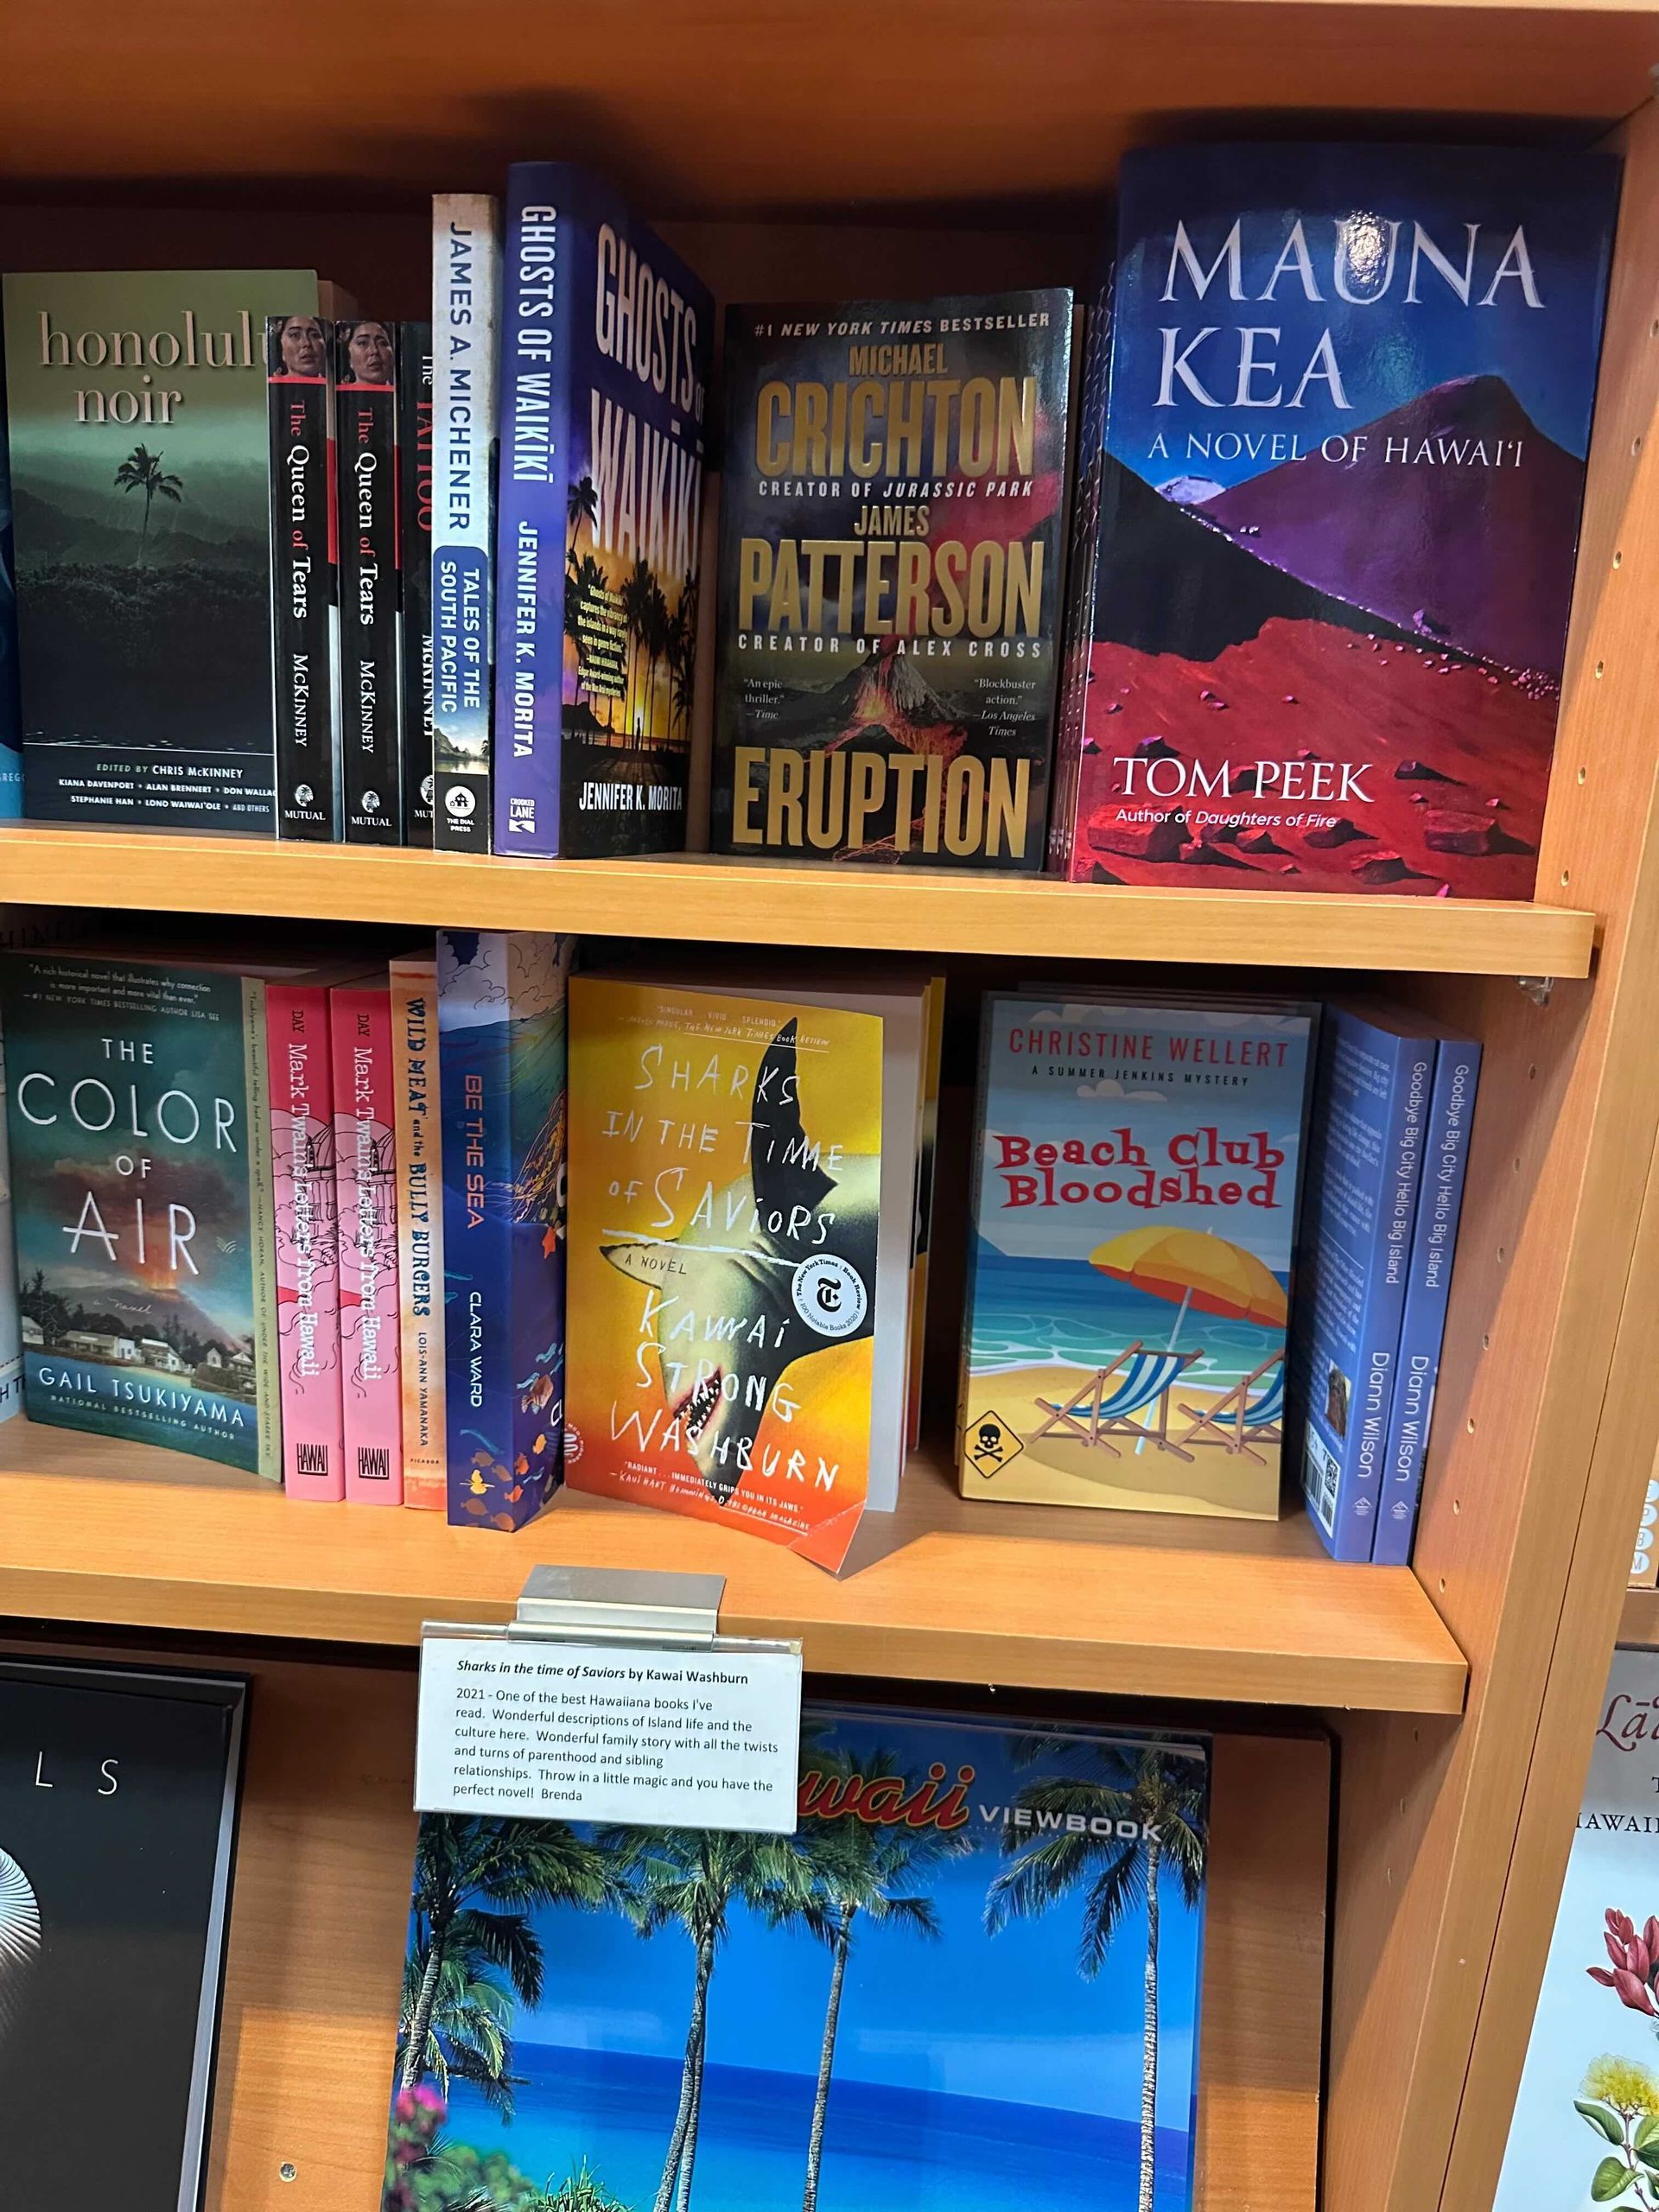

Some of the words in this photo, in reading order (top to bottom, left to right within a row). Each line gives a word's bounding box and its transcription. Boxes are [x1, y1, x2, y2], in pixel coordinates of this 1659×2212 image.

[450, 221, 472, 326] JAMES
[518, 206, 556, 317] GHOSTS
[1158, 218, 1546, 308] MAUNA
[450, 335, 471, 360] A.
[518, 328, 553, 362] OF
[754, 323, 772, 337] #1
[781, 323, 819, 336] NEW
[828, 322, 872, 335] YORK
[881, 321, 932, 334] TIMES
[940, 312, 1050, 333] BESTSELLER
[849, 342, 948, 376] MICHAEL
[1152, 327, 1355, 409] KEA
[74, 374, 182, 423] noir
[290, 400, 306, 436] The
[449, 369, 471, 530] MICHENER
[756, 376, 1037, 477] CRICHTON
[1147, 433, 1168, 460] A
[1186, 432, 1306, 461] NOVEL
[1321, 435, 1368, 463] OF
[287, 444, 309, 522] Queen
[759, 480, 841, 498] CREATOR
[851, 480, 873, 498] OF
[883, 480, 976, 498] JURASSIC
[986, 480, 1033, 497] PARK
[292, 530, 308, 550] of
[854, 505, 931, 537] JAMES
[292, 556, 311, 619] Tears
[441, 562, 457, 629] SOUTH
[463, 568, 480, 632] TALES
[516, 521, 537, 635] JENNIFER
[739, 537, 1045, 639] PATTERSON
[463, 637, 480, 664] OF
[515, 642, 535, 664] K.
[739, 634, 839, 653] CREATOR
[856, 639, 881, 654] OF
[898, 639, 951, 657] ALEX
[969, 641, 1041, 658] CROSS
[441, 636, 457, 713] PACIFIC
[463, 671, 480, 709] THE
[293, 654, 309, 747] McKINNEY
[513, 671, 535, 758] MORITA
[97, 764, 130, 772] EDITED
[152, 766, 184, 776] CHRIS
[188, 766, 244, 779] McKINNEY
[1113, 757, 1231, 798] TOM
[1255, 760, 1375, 803] PEEK
[285, 810, 326, 821] MUTUAL
[510, 806, 535, 818] LANE
[733, 747, 1030, 858] ERUPTION
[1116, 809, 1172, 823] Author
[1175, 810, 1192, 824] of
[1195, 811, 1281, 828] Daughters
[1285, 813, 1305, 827] of
[1306, 814, 1337, 828] Fire
[292, 1010, 304, 1033] DAY
[406, 998, 426, 1052] WILD
[101, 1039, 154, 1065] THE
[289, 1043, 309, 1099] Mark
[1009, 1027, 1154, 1061] CHRISTINE
[1169, 1038, 1289, 1067] WELLERT
[408, 1059, 428, 1117] MEAT
[465, 1075, 482, 1110] BE
[634, 1043, 800, 1106] SHARKS
[1032, 1065, 1039, 1075] A
[1048, 1065, 1106, 1078] SUMMER
[1115, 1068, 1174, 1083] JENKINS
[1185, 1073, 1249, 1087] MYSTERY
[1404, 1062, 1427, 1123] Goodbye
[18, 1073, 236, 1153] COLOR
[412, 1120, 423, 1138] and
[1400, 1127, 1419, 1148] Big
[413, 1141, 425, 1156] the
[465, 1116, 483, 1167] THE
[602, 1109, 643, 1143] IN
[658, 1120, 718, 1154] THE
[735, 1121, 843, 1171] TIME
[993, 1128, 1151, 1168] Beach
[1168, 1127, 1285, 1169] Club
[1396, 1150, 1415, 1179] City
[116, 1155, 151, 1179] OF
[1001, 1166, 1282, 1209] Bloodshed
[295, 1182, 314, 1254] Letters
[409, 1164, 429, 1224] BULLY
[467, 1173, 484, 1229] SEA
[1395, 1182, 1412, 1217] Hello
[62, 1191, 199, 1275] AIR
[1388, 1219, 1407, 1241] Big
[296, 1258, 315, 1307] from
[411, 1230, 430, 1317] BURGERS
[625, 1254, 632, 1265] A
[640, 1255, 688, 1275] NOVEL
[1385, 1244, 1404, 1285] Island
[301, 1313, 320, 1377] Hawaii
[469, 1292, 482, 1351] CLARA
[417, 1332, 428, 1388] LOIS-ANN
[469, 1356, 482, 1408] WARD
[636, 1340, 801, 1423] STRONG
[1366, 1352, 1389, 1411] Diann
[39, 1368, 97, 1393] GAIL
[111, 1379, 244, 1427] TSUKIYAMA
[419, 1389, 429, 1446] YAMANAKA
[611, 1401, 839, 1491] WASHBURN
[1357, 1415, 1382, 1478] Wilson
[457, 1660, 496, 1672] Sharks
[499, 1662, 511, 1673] in
[514, 1662, 534, 1675] the
[537, 1664, 563, 1675] time
[567, 1665, 581, 1679] of
[582, 1666, 626, 1678] Saviors
[629, 1668, 643, 1681] by
[646, 1669, 683, 1681] Kawai
[686, 1671, 748, 1684] Washburn
[456, 1688, 484, 1700] 2021
[496, 1690, 520, 1701] One
[524, 1691, 536, 1702] of
[539, 1692, 558, 1703] the
[562, 1693, 586, 1705] best
[590, 1694, 650, 1707] Hawaiiana
[654, 1697, 689, 1710] books
[693, 1699, 712, 1711] I've
[456, 1707, 485, 1718] read.
[493, 1709, 555, 1722] Wonderful
[558, 1712, 629, 1727] descriptions
[632, 1716, 645, 1726] of
[648, 1716, 682, 1728] Island
[686, 1718, 703, 1730] life
[707, 1719, 729, 1731] and
[733, 1720, 752, 1732] the
[454, 1726, 496, 1738] culture
[499, 1728, 529, 1740] here.
[536, 1731, 599, 1744] Wonderful
[602, 1733, 638, 1749] family
[641, 1737, 671, 1750] story
[674, 1738, 700, 1749] with
[703, 1738, 717, 1749] all
[721, 1739, 740, 1751] the
[744, 1742, 778, 1752] twists
[979, 1803, 1164, 1842] VIEWBOOK
